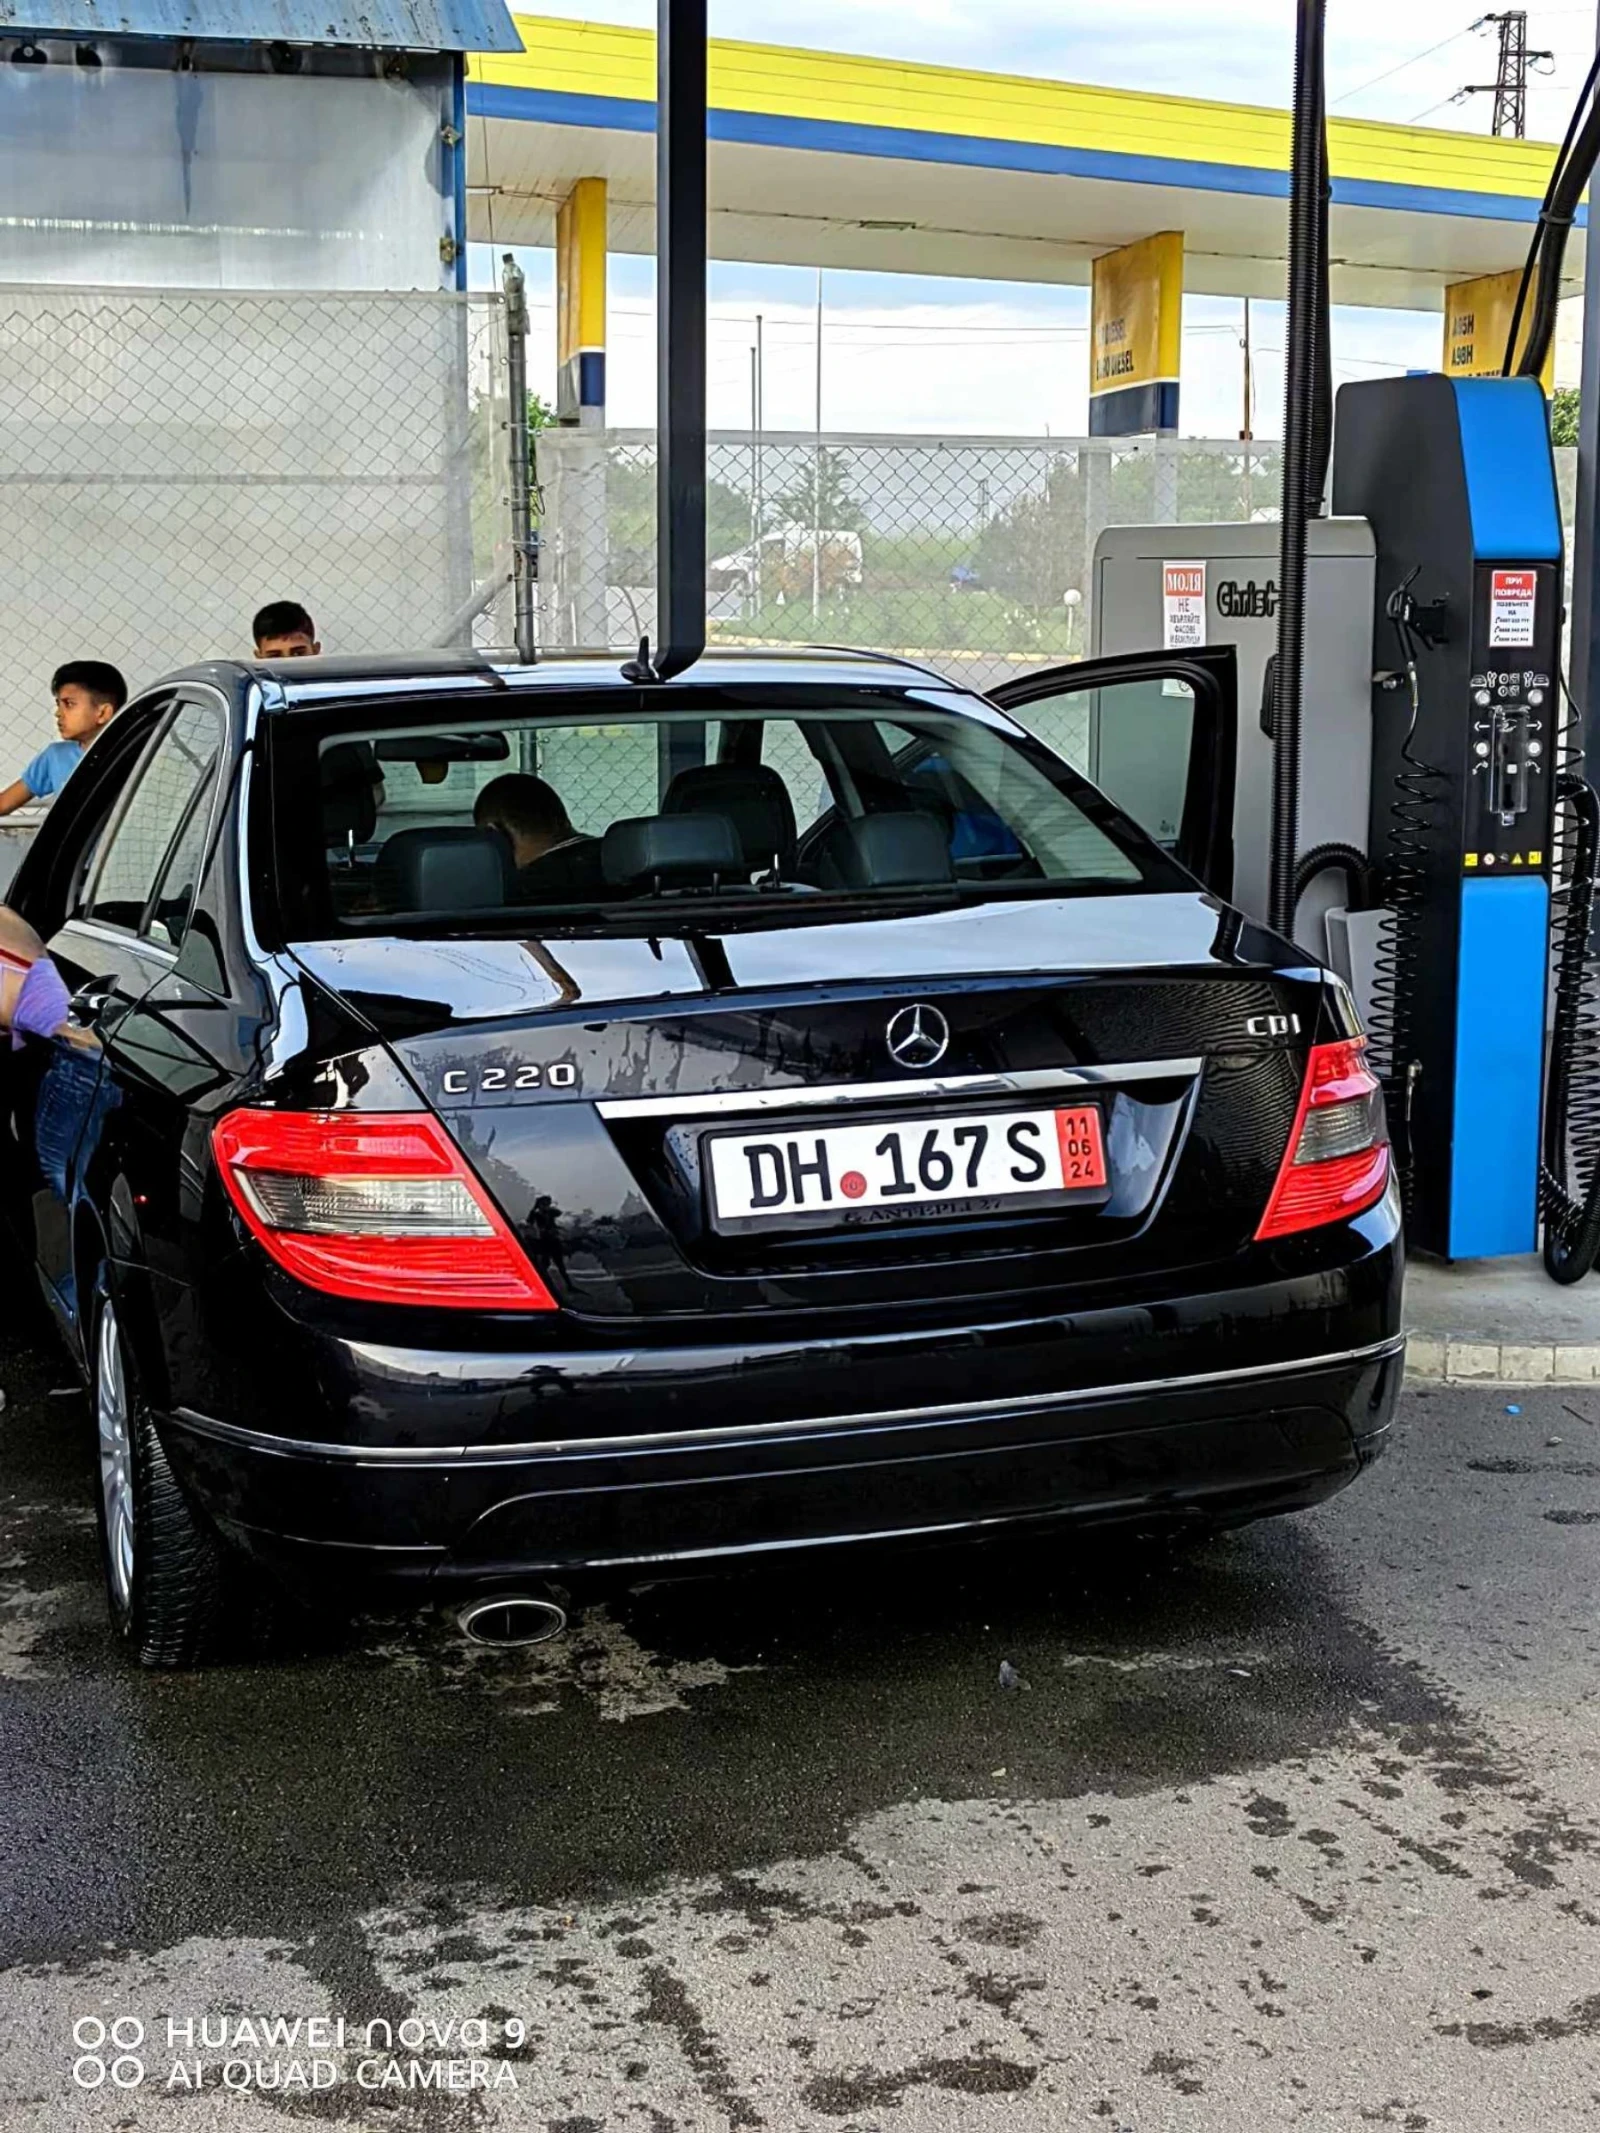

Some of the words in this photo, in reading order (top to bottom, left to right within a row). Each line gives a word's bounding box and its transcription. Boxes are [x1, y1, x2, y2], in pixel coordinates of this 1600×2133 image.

[1167, 573, 1201, 593] МОЛЯ
[1505, 576, 1523, 585] ПРИ
[1216, 579, 1282, 618] Christ
[1495, 588, 1532, 598] ПОВРЕДА
[1178, 598, 1190, 613] НЕ
[1247, 1012, 1302, 1038] CDI
[443, 1068, 469, 1094] C
[480, 1062, 576, 1090] 220
[1066, 1116, 1088, 1136] 11
[1068, 1138, 1092, 1157] 06
[742, 1138, 833, 1209] DH
[875, 1123, 989, 1197] 167
[1005, 1119, 1047, 1183] S
[1070, 1160, 1095, 1179] 24
[979, 1198, 1002, 1211] 27
